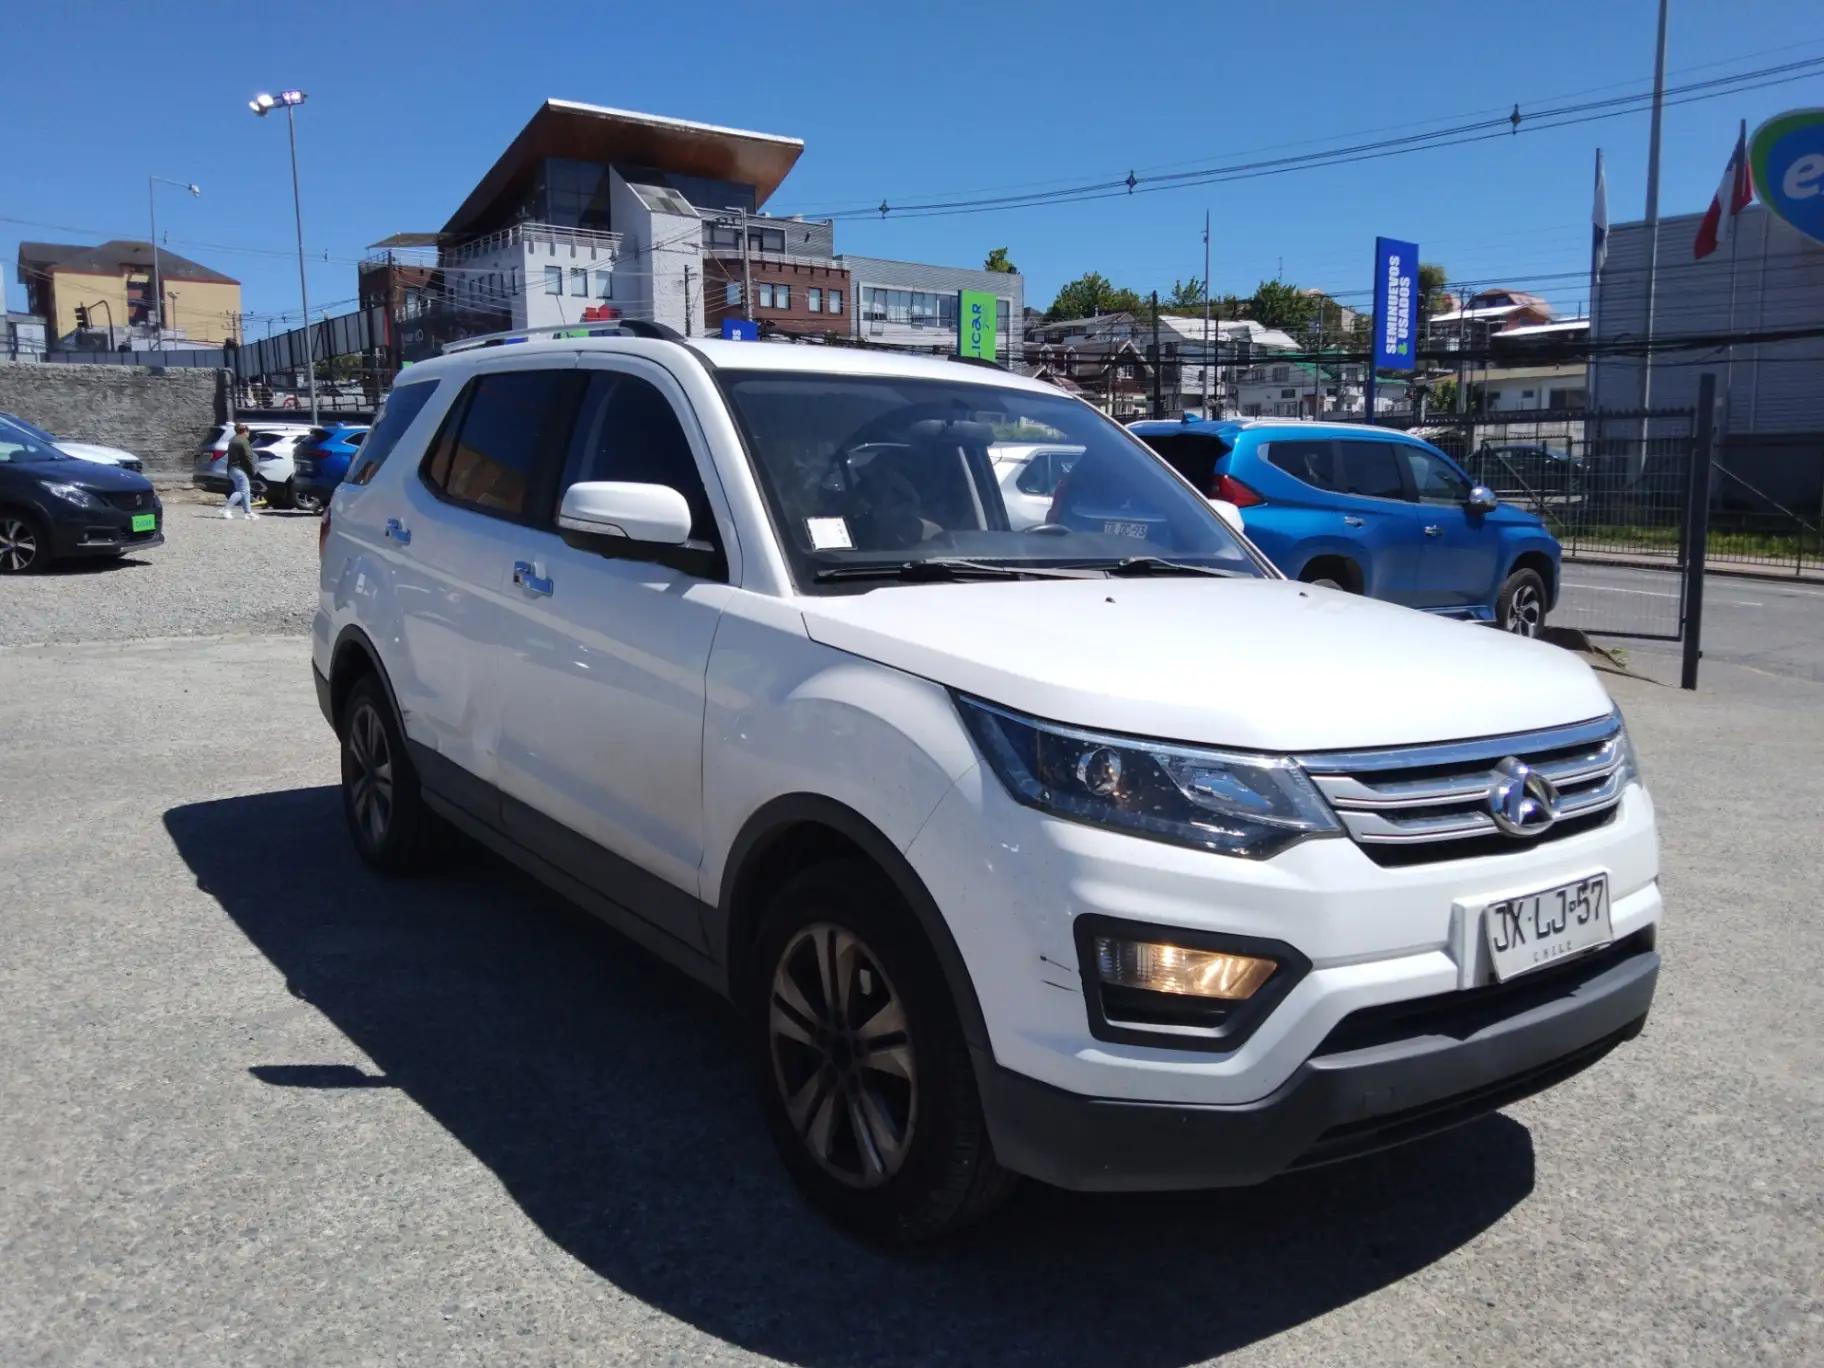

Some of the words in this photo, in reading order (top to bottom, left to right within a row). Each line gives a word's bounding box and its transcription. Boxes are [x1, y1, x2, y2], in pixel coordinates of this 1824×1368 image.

[1782, 153, 1824, 199] e
[1386, 255, 1400, 354] SEMINUEVOS
[1398, 277, 1410, 339] USADOS
[1533, 941, 1573, 962] CHILE
